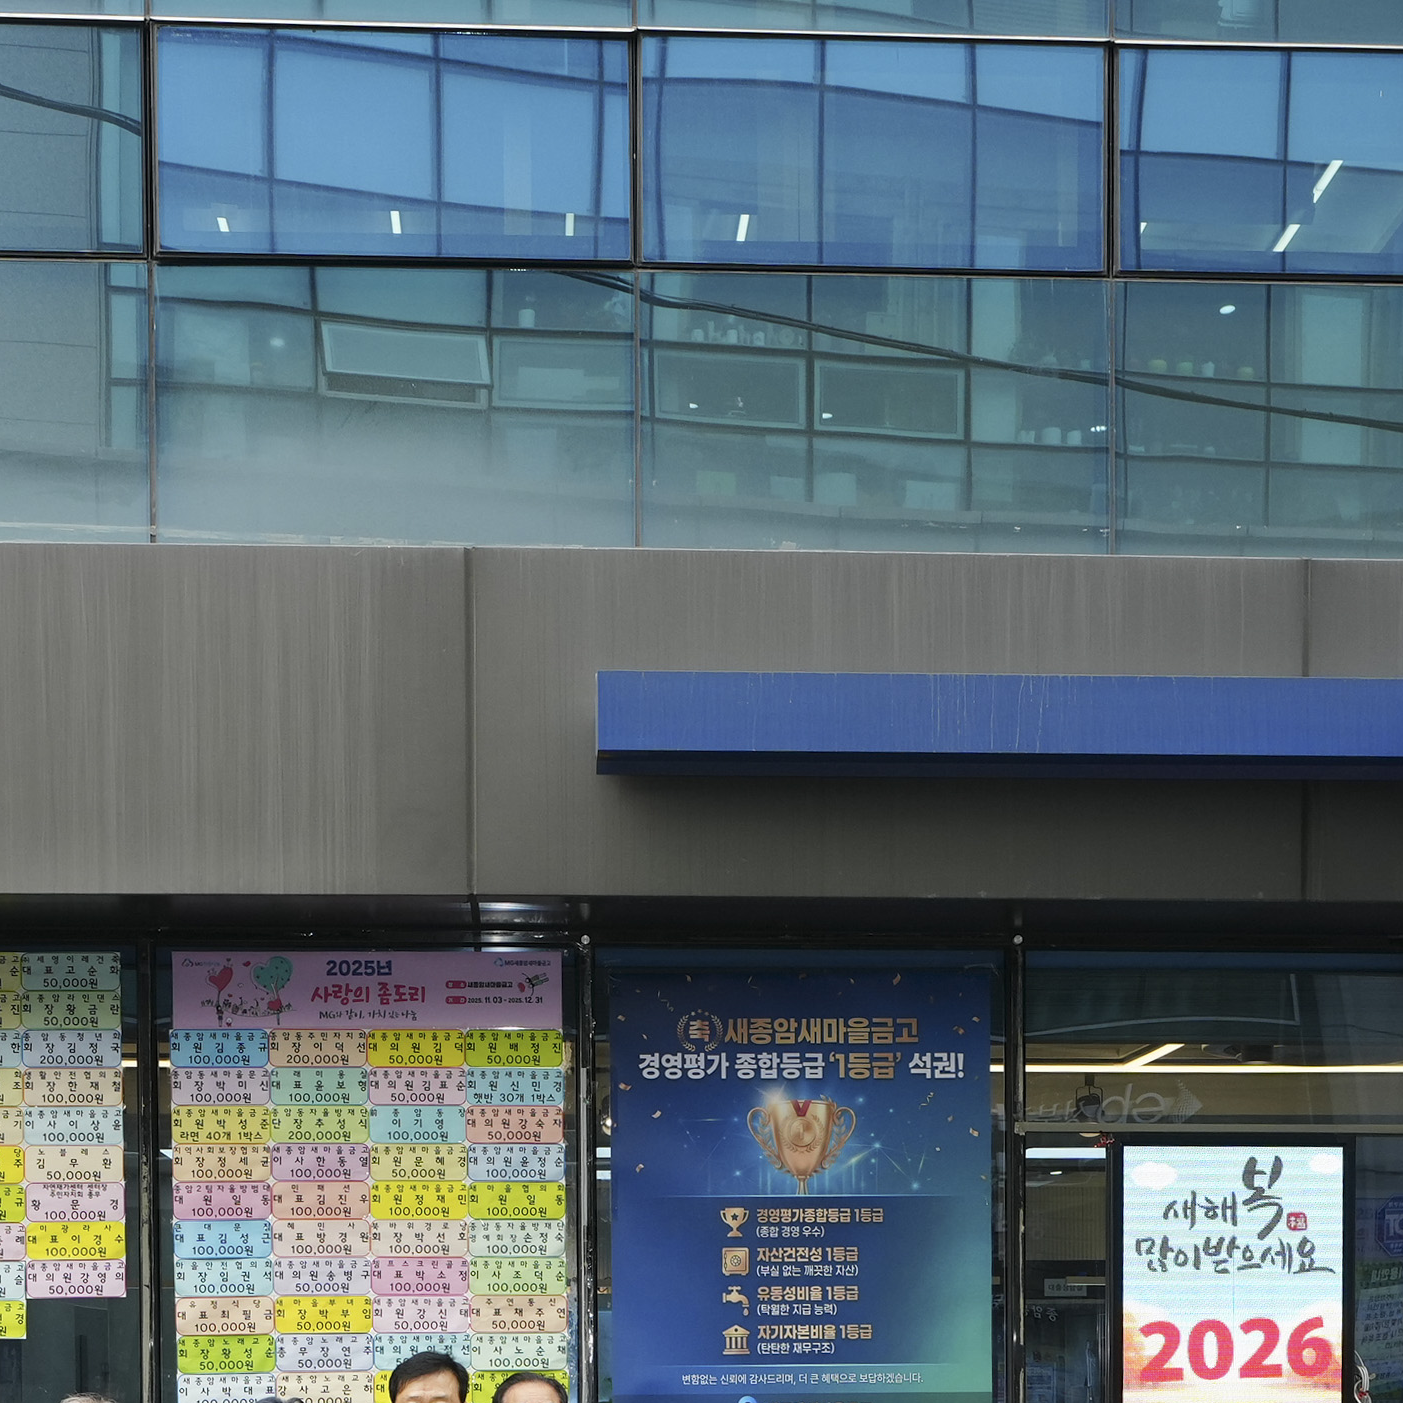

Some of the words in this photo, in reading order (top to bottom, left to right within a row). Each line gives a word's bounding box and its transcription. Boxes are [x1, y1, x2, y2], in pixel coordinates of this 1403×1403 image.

[326, 958, 392, 977] 2025년
[311, 982, 370, 1005] 사랑의
[377, 981, 426, 1005] 좀도리
[688, 1021, 711, 1042] 축
[724, 1017, 919, 1044] 새종암새마을금고
[39, 1055, 105, 1068] 200,000원
[286, 1054, 350, 1067] 200,000원
[638, 1052, 729, 1079] 경영평가
[734, 1052, 825, 1079] 종합등급
[908, 1052, 965, 1079] 석권!
[472, 1091, 494, 1104] 햇반
[499, 1091, 525, 1104] 30개
[531, 1091, 556, 1104] 1박스
[179, 1130, 202, 1142] 라면
[205, 1130, 232, 1142] 40개
[237, 1130, 263, 1142] 1박스
[1162, 1190, 1238, 1230] 새해
[1241, 1155, 1284, 1240] 복
[756, 1208, 851, 1223] 경영평가종합등급
[854, 1208, 884, 1222] 1등급
[756, 1226, 779, 1238] (종합
[781, 1226, 800, 1238] 경영
[802, 1226, 825, 1238] 우수)
[756, 1247, 823, 1262] 자산건전성
[825, 1247, 859, 1262] 1등급
[1135, 1235, 1336, 1275] 많이받으세요
[756, 1265, 780, 1277] (부실
[782, 1265, 801, 1277] 없는
[804, 1265, 833, 1277] 깨끗한
[835, 1265, 859, 1277] 자산)
[486, 1282, 548, 1295] 100,000원
[757, 1286, 823, 1301] 유동성비율
[826, 1286, 859, 1301] 1등급
[757, 1303, 790, 1316] (탁월한
[792, 1303, 812, 1316] 지급
[814, 1303, 838, 1316] 능력)
[757, 1324, 836, 1340] 자기자본비율
[839, 1324, 873, 1340] 1등급
[757, 1342, 790, 1355] (탄탄한
[792, 1342, 835, 1355] 재무구조)
[1139, 1315, 1333, 1383] 2026
[198, 1358, 255, 1371] 50,000원
[681, 1373, 718, 1385] 변함없는
[720, 1373, 747, 1385] 신뢰에
[749, 1373, 796, 1385] 감사드리며,
[798, 1373, 808, 1385] 더
[809, 1373, 820, 1385] 큰
[821, 1373, 857, 1384] 혜택으로
[859, 1373, 924, 1384] 보답하겠습니다.
